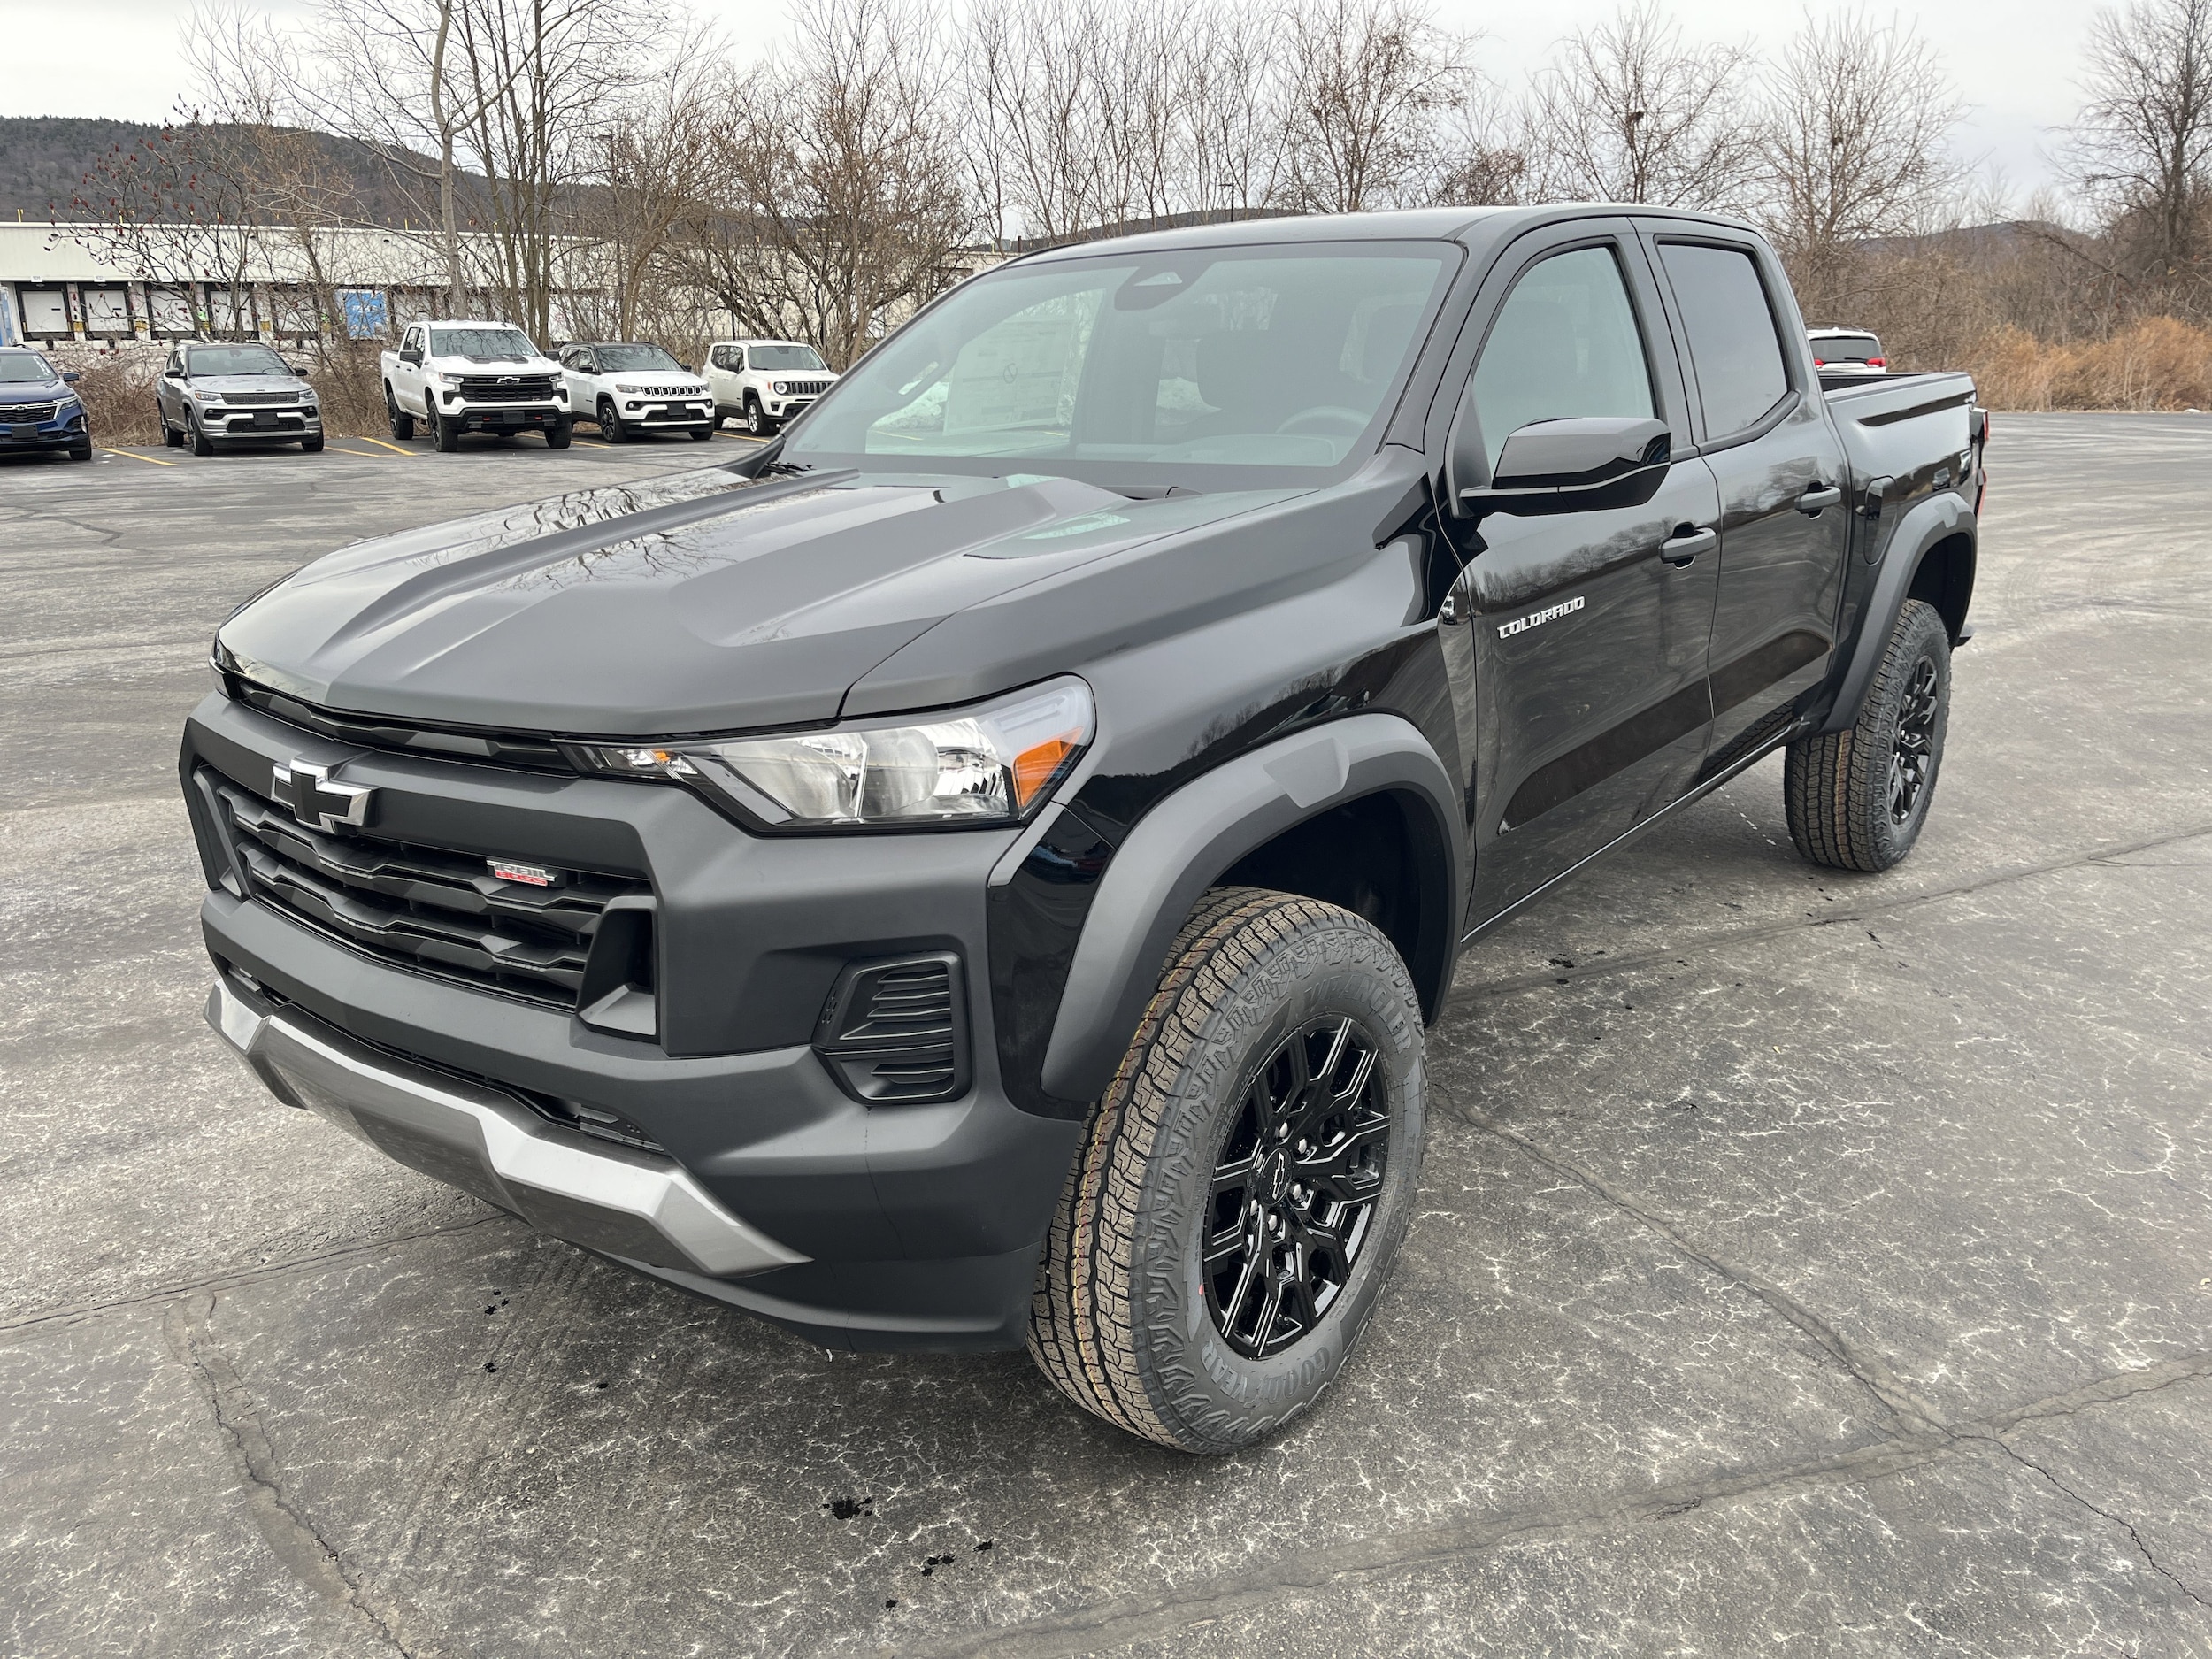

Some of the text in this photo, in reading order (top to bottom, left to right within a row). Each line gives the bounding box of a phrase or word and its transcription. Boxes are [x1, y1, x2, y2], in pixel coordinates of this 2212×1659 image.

[1497, 596, 1585, 639] COLORADO
[486, 860, 556, 882] TRAIL
[495, 870, 548, 887] BOSS
[1304, 974, 1413, 1055] WRANGLER
